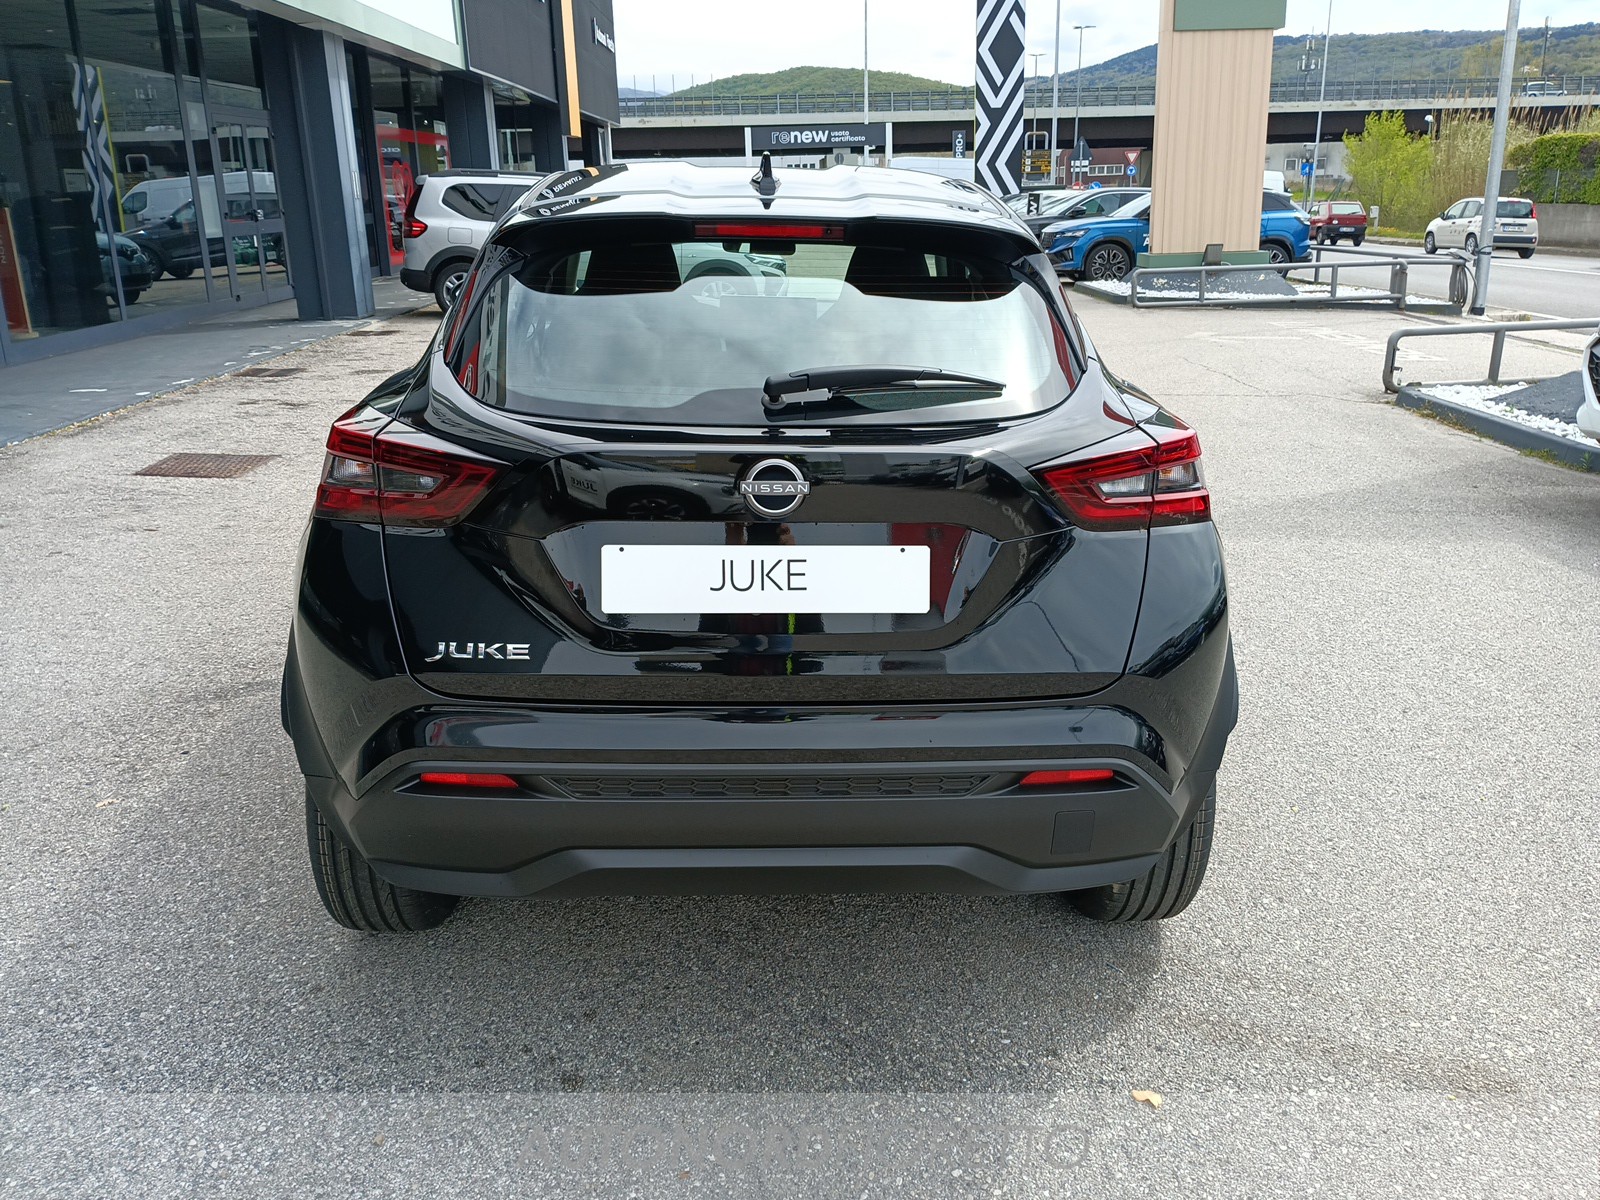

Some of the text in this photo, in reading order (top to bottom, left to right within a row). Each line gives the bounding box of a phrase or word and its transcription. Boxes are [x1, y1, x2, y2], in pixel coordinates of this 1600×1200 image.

[771, 129, 829, 144] renew
[830, 134, 866, 143] certificato
[955, 133, 964, 158] PRO+
[740, 482, 810, 494] NISSAN
[710, 559, 808, 592] JUKE
[424, 641, 531, 664] JUKE
